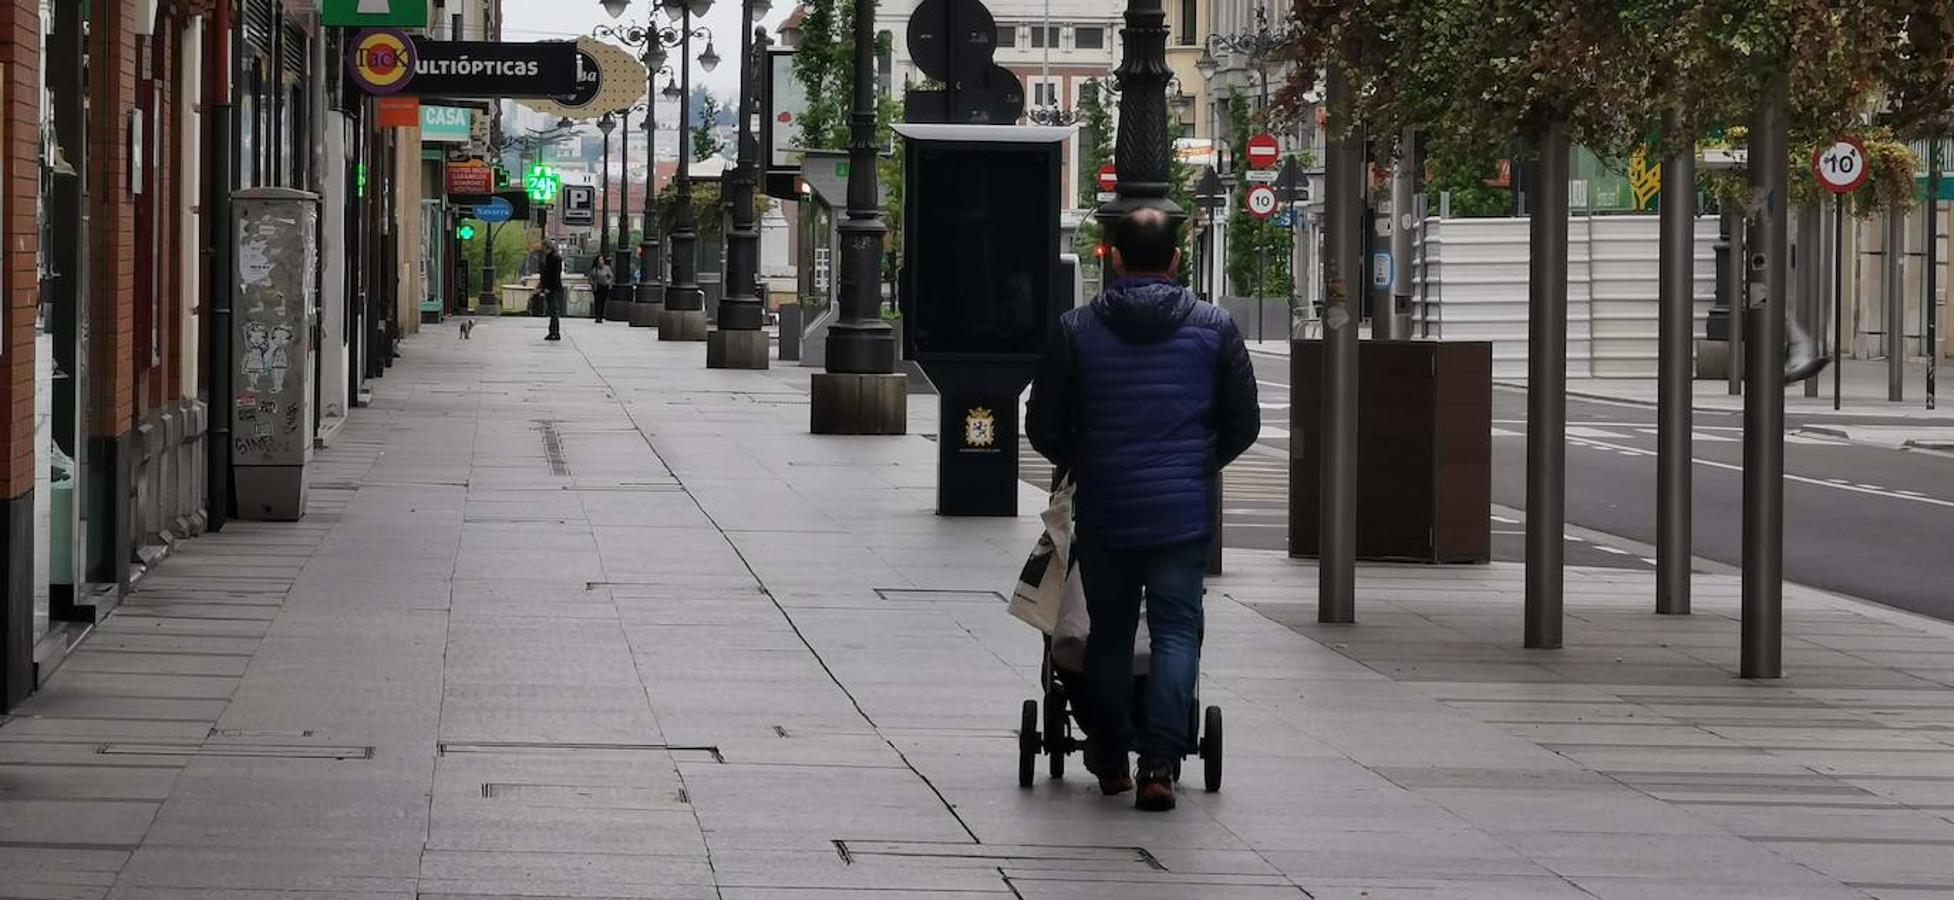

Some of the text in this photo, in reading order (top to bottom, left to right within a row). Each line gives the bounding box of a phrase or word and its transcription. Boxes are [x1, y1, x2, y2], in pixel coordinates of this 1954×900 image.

[415, 55, 539, 76] ULTIÓPTICAS
[426, 107, 466, 126] CASA
[1830, 154, 1854, 173] 10
[529, 175, 557, 193] 24h
[569, 189, 588, 210] P
[1255, 196, 1270, 208] 10
